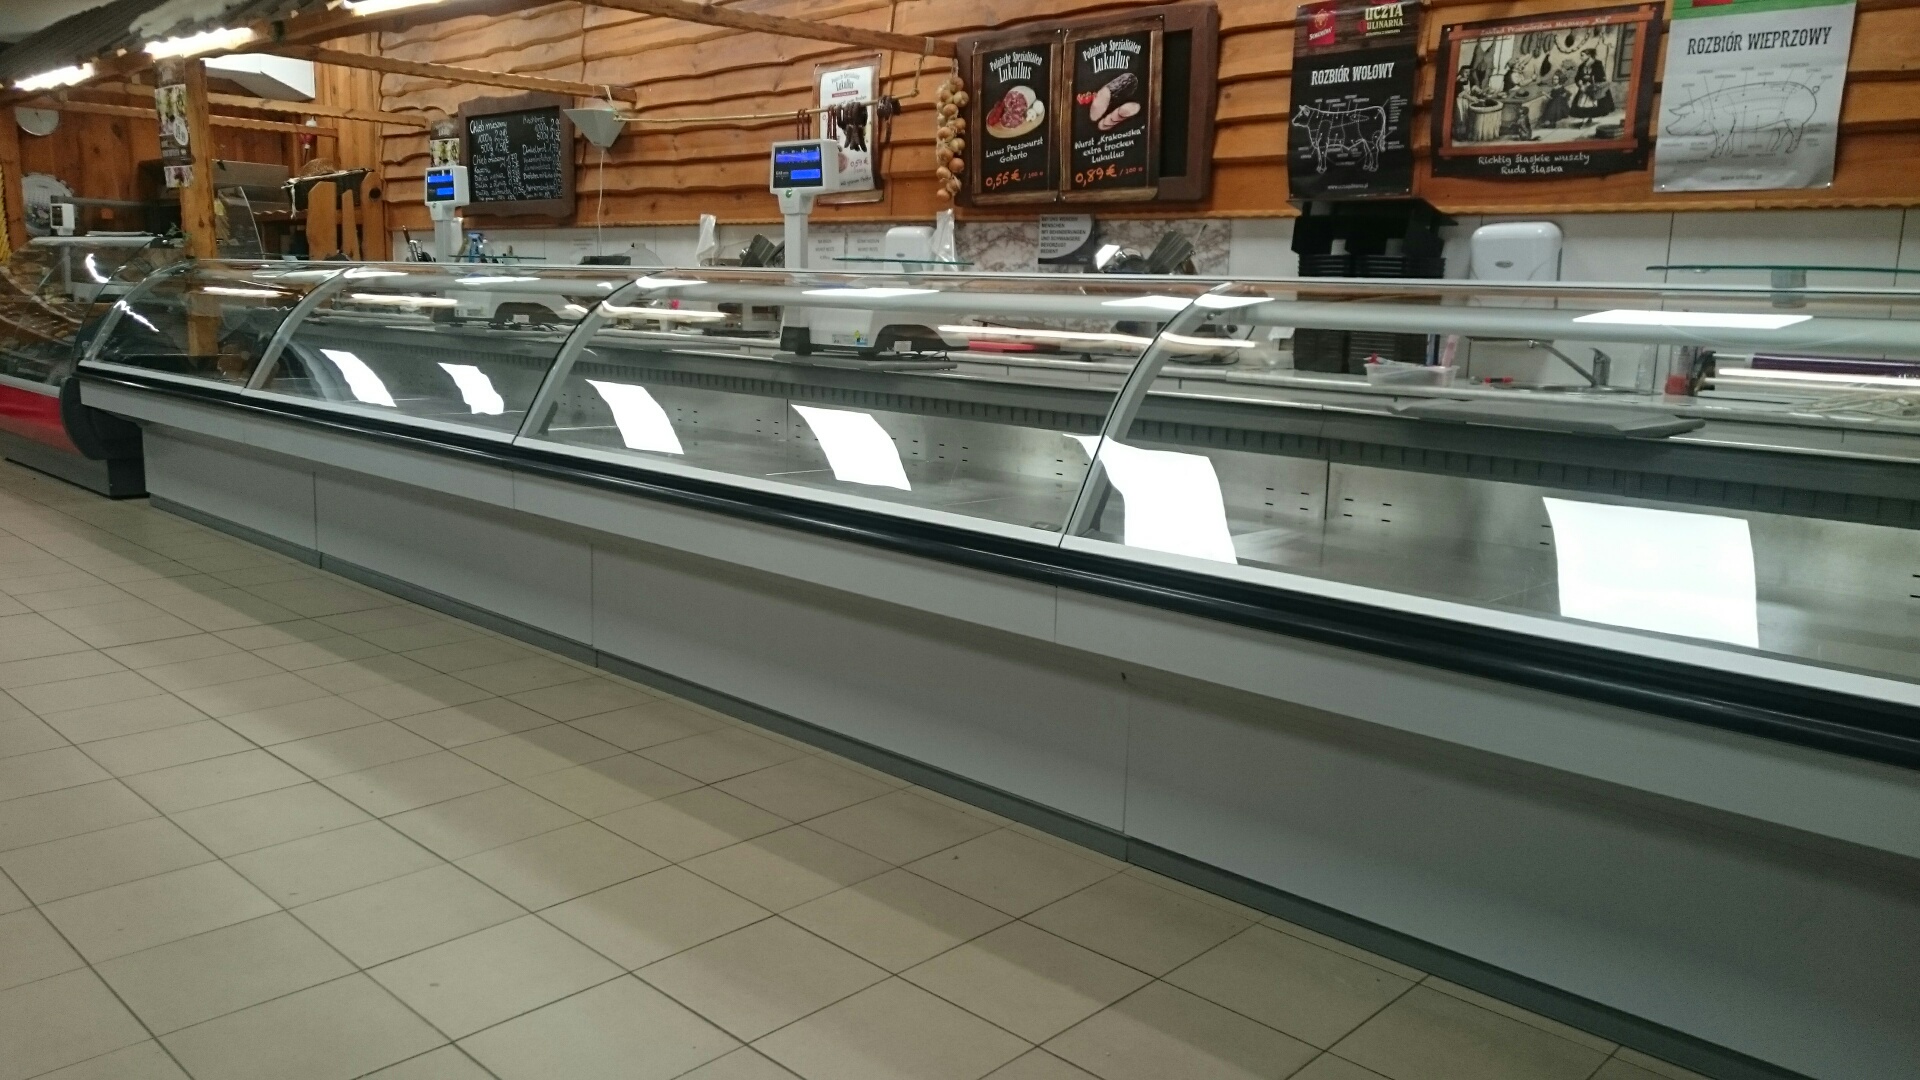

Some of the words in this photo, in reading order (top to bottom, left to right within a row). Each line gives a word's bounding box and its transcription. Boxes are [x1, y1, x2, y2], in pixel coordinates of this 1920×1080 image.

[1365, 3, 1404, 21] UCZTA
[1082, 41, 1108, 61] Polnische
[1109, 39, 1142, 54] Spezialitäten
[1687, 31, 1743, 56] ROZBIÓR
[1747, 26, 1833, 51] WIEPRZOWY
[989, 53, 1011, 71] Polnische
[1012, 51, 1043, 66] Spezialitäten
[1093, 50, 1131, 74] Lukullus
[998, 62, 1032, 83] Lukullus
[1311, 64, 1350, 86] ROZBIÓR
[1352, 62, 1395, 82] WOŁOWY
[985, 147, 1005, 158] Luxus
[1006, 135, 1044, 152] Presswurst
[1074, 137, 1095, 150] Wurst
[1083, 146, 1102, 156] extra
[1104, 140, 1135, 151] trocken
[999, 150, 1028, 163] Gobarto
[1091, 150, 1125, 163] Lukullus
[1478, 154, 1512, 166] Richtig
[1500, 165, 1527, 175] Ruda
